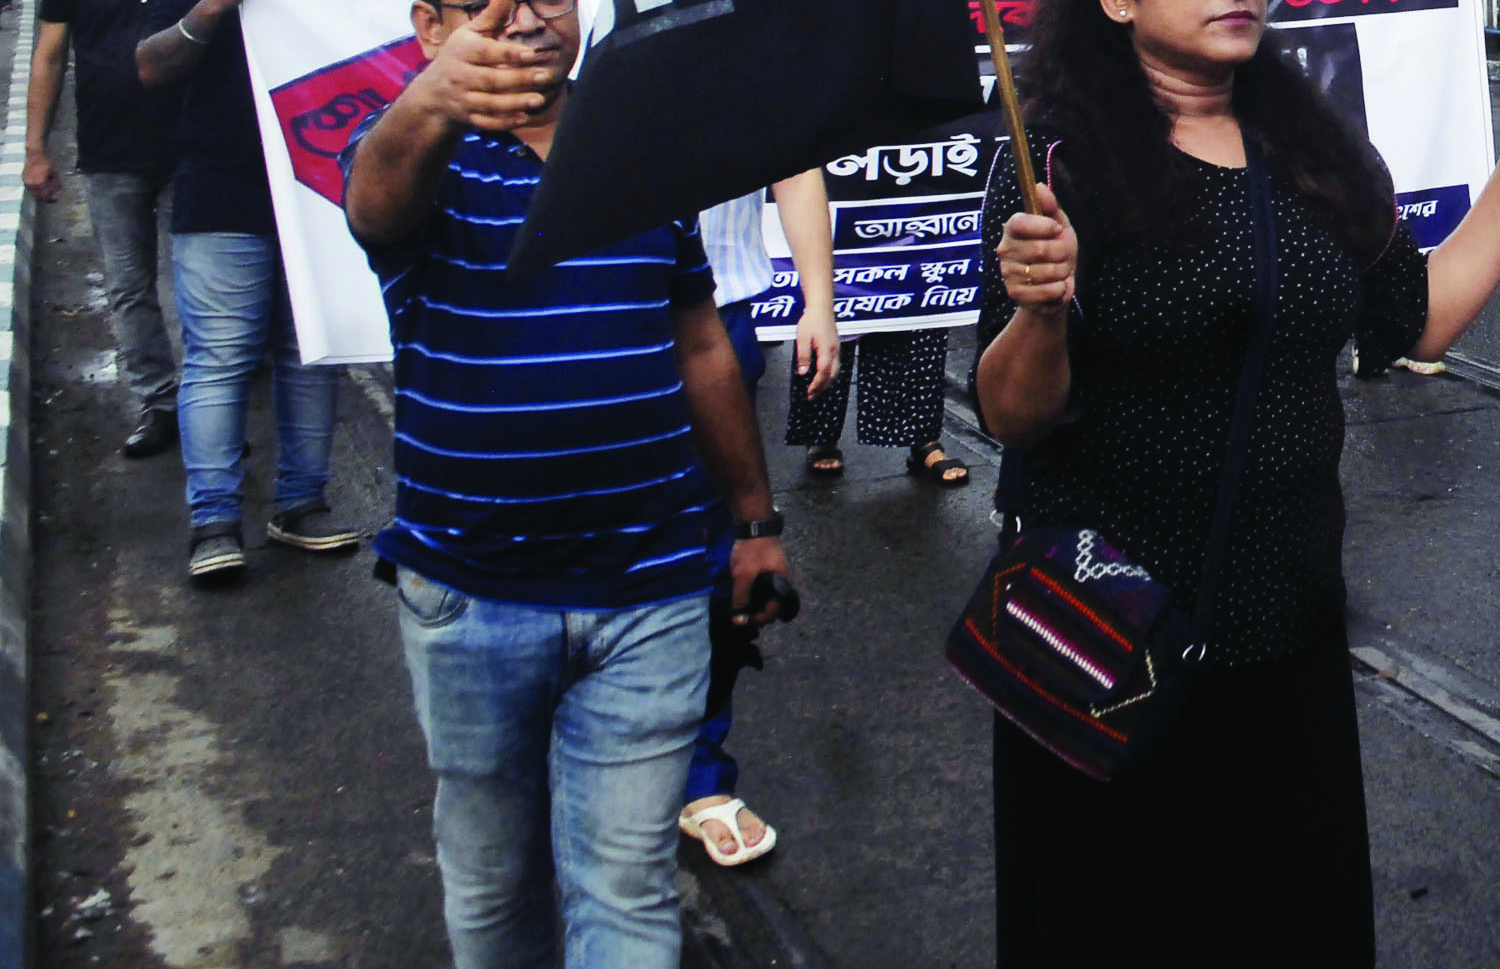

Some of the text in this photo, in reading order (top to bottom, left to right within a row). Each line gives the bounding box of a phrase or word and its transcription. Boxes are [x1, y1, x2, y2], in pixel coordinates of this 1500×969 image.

[826, 133, 981, 186] লড়াই
[854, 211, 981, 239] আহ্বানে
[833, 264, 911, 285] সকল
[921, 259, 971, 283] স্কুল
[920, 286, 978, 307] নিয়ে
